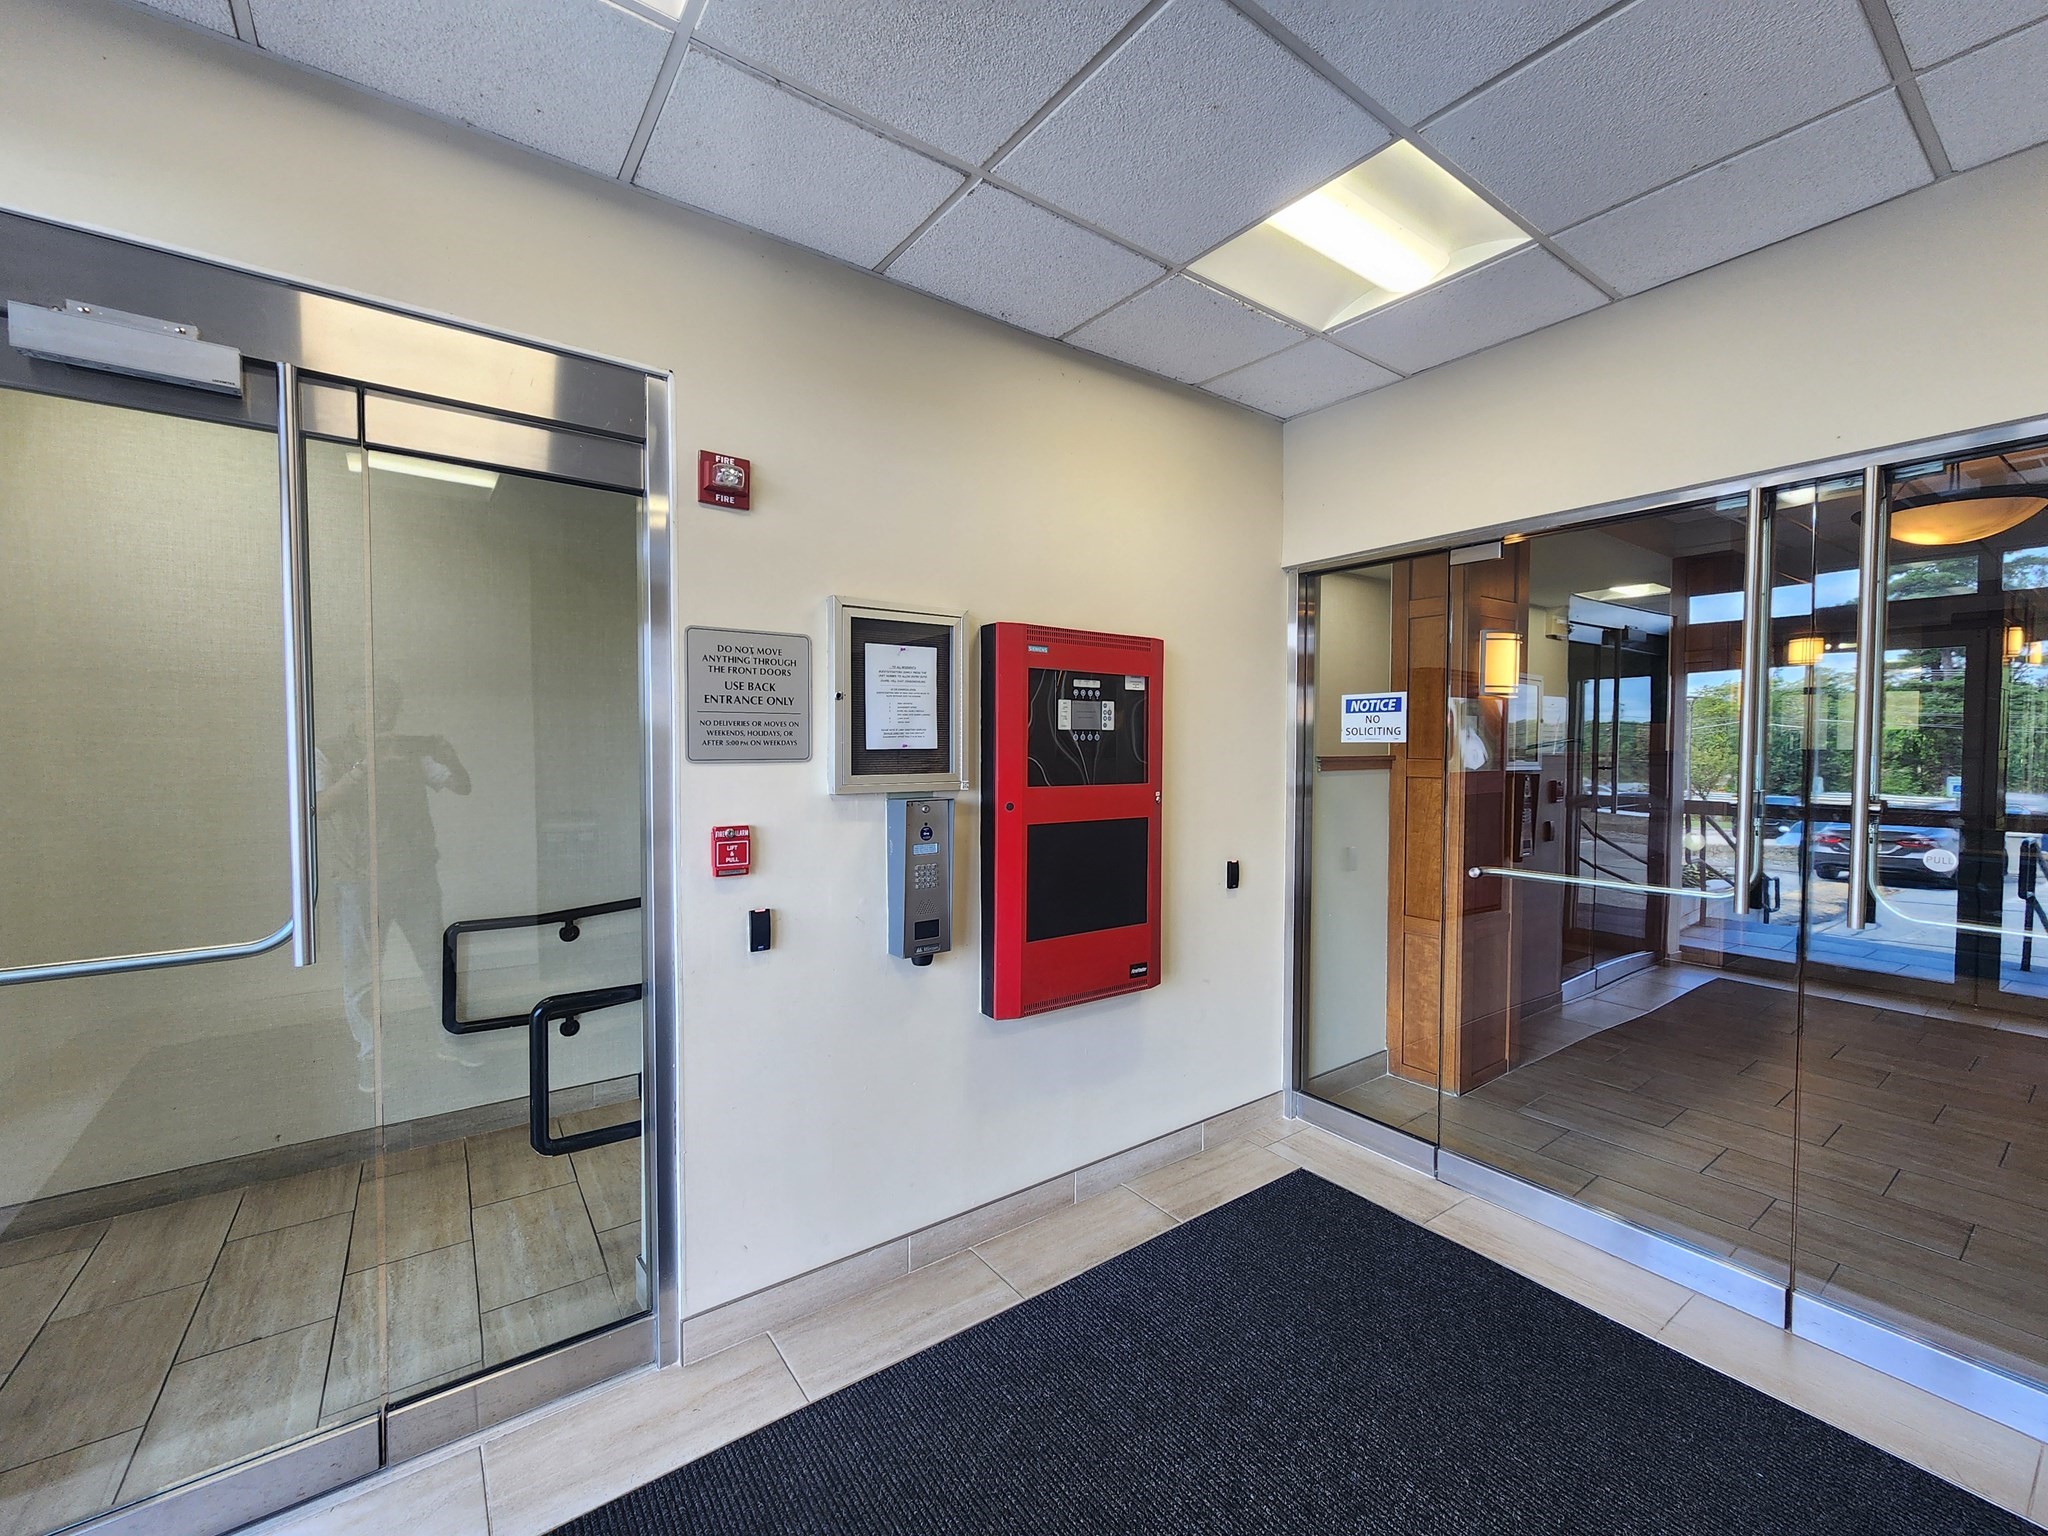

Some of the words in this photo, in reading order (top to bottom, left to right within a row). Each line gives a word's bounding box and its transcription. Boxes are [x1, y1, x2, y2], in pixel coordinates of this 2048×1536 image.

[715, 455, 735, 466] FIRE
[715, 494, 735, 504] FIRE
[717, 644, 732, 653] DO
[734, 646, 755, 655] NOT
[756, 647, 783, 656] MOVE
[702, 654, 751, 665] ANYTHING
[753, 657, 797, 667] THROUGH
[708, 665, 725, 674] THE
[727, 666, 757, 675] FRONT
[759, 668, 792, 677] DOORS
[724, 681, 744, 691] USE
[748, 682, 776, 692] BACK
[704, 694, 763, 706] ENTRANCE
[766, 696, 795, 706] ONLY
[1350, 698, 1397, 712] NOTICE
[1365, 715, 1380, 724] NO
[706, 729, 746, 737] WEEKENDS,
[747, 730, 782, 738] HOLIDAYS,
[1345, 726, 1401, 736] SOLICITING
[763, 739, 798, 747] WEEKDAYS
[1926, 855, 1954, 865] PULL
